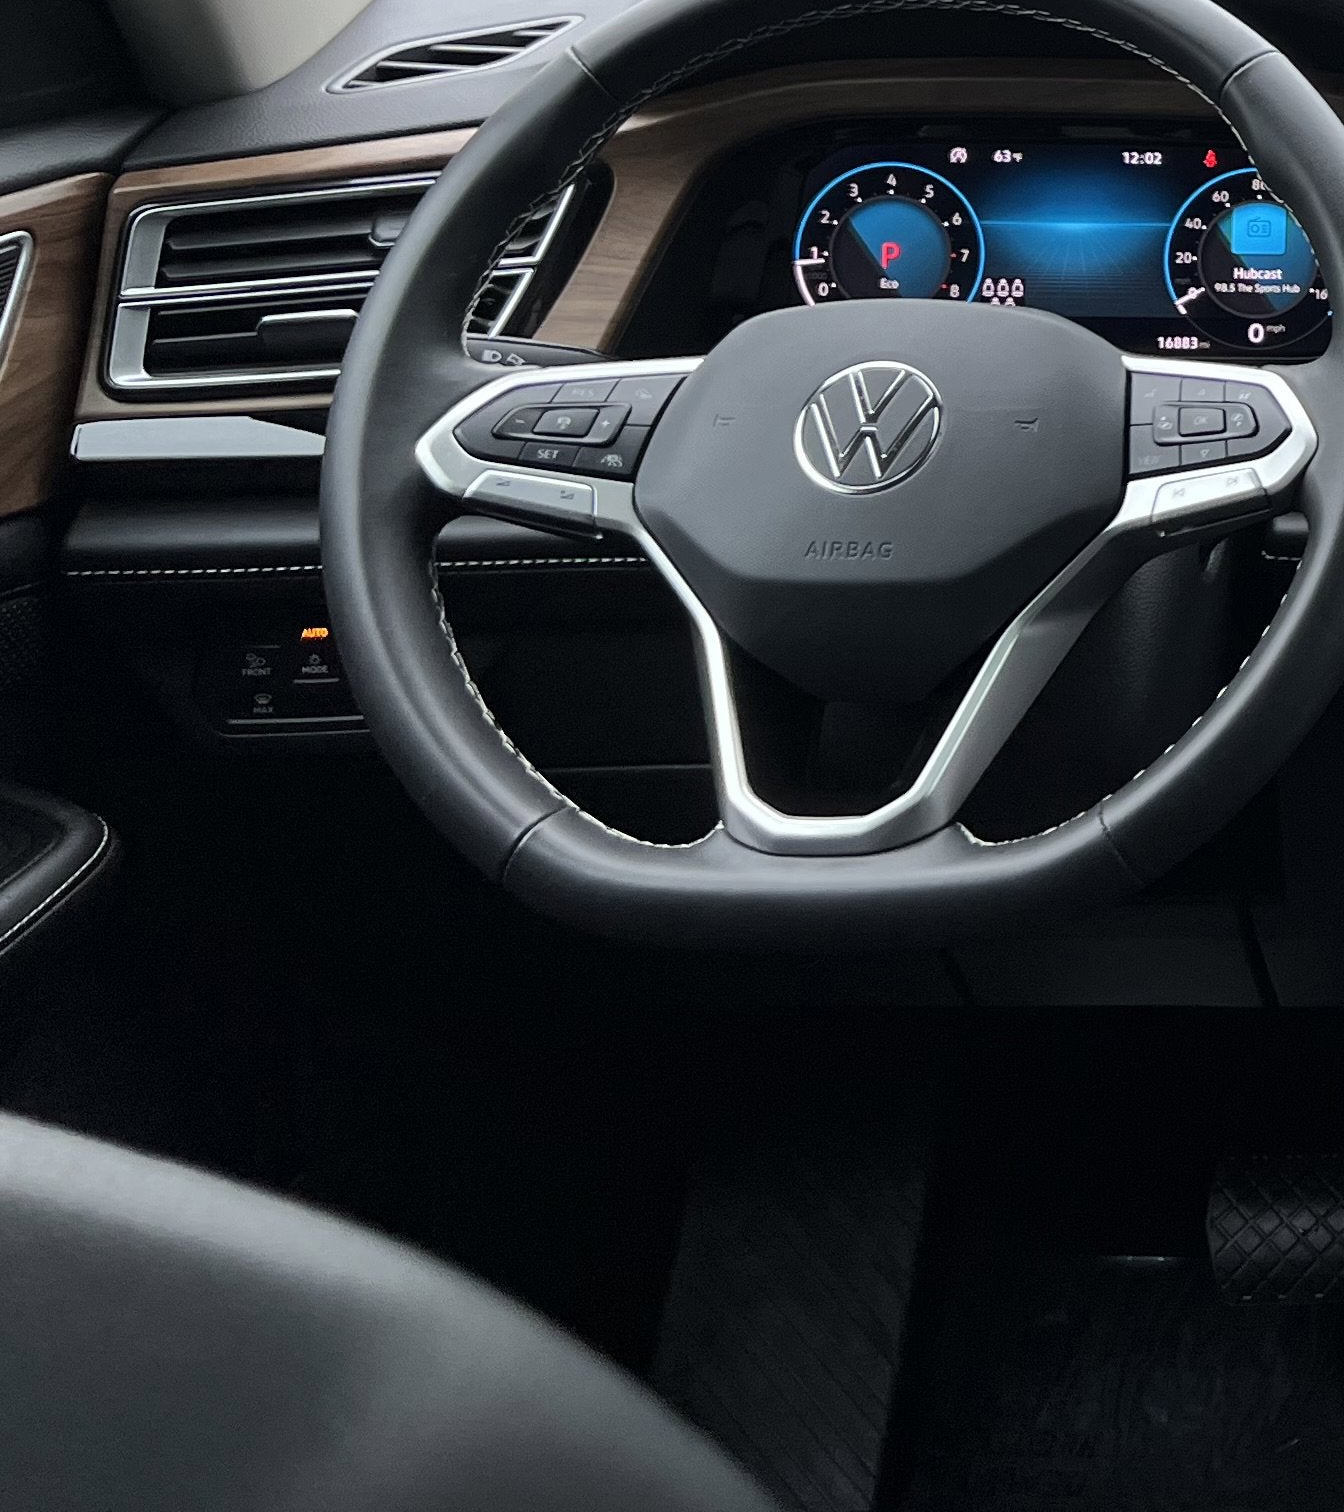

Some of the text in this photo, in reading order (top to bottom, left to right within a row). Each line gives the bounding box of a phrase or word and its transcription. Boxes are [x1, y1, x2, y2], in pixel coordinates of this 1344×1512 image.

[1121, 151, 1162, 165] 12:02
[886, 173, 897, 187] 4
[848, 182, 859, 198] 3
[925, 183, 935, 199] 5
[1211, 190, 1230, 203] 60
[819, 209, 831, 225] 2
[952, 212, 963, 226] 6
[1184, 217, 1202, 229] 40
[880, 241, 902, 270] P
[960, 248, 970, 263] 7
[1174, 251, 1193, 264] 20
[1232, 267, 1283, 280] Hubcast
[817, 281, 830, 297] 0
[879, 276, 900, 290] Eco
[1237, 283, 1253, 294] The
[1282, 283, 1301, 294] Hub
[949, 283, 960, 298] 8
[1246, 322, 1265, 344] 0
[537, 449, 559, 460] SET
[804, 540, 893, 561] AIRBAG
[302, 627, 329, 640] AUTO
